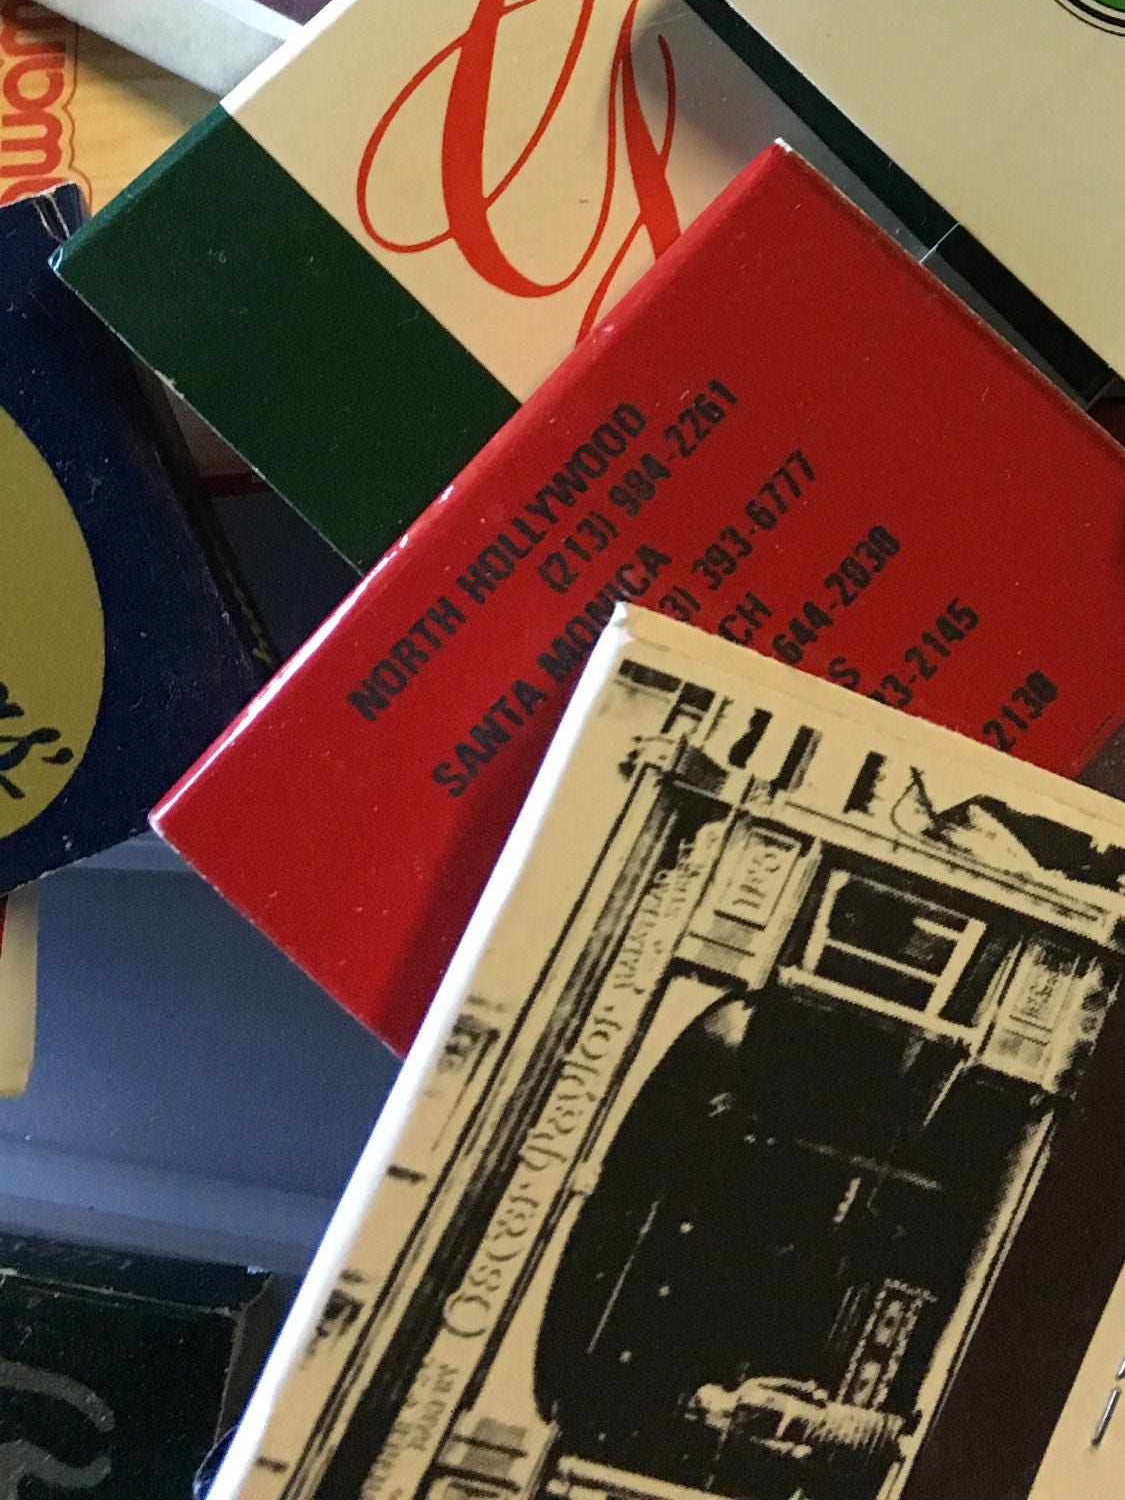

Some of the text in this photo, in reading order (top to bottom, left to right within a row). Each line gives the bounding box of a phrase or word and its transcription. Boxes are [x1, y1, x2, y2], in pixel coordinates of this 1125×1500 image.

[345, 401, 648, 723] NORTH HOLLYWOOD
[536, 378, 740, 595] (213) 984-2261
[691, 446, 818, 592] 393-6777
[772, 523, 901, 665] 644-2030
[431, 678, 549, 799] SANTA
[536, 543, 673, 683] MONICA
